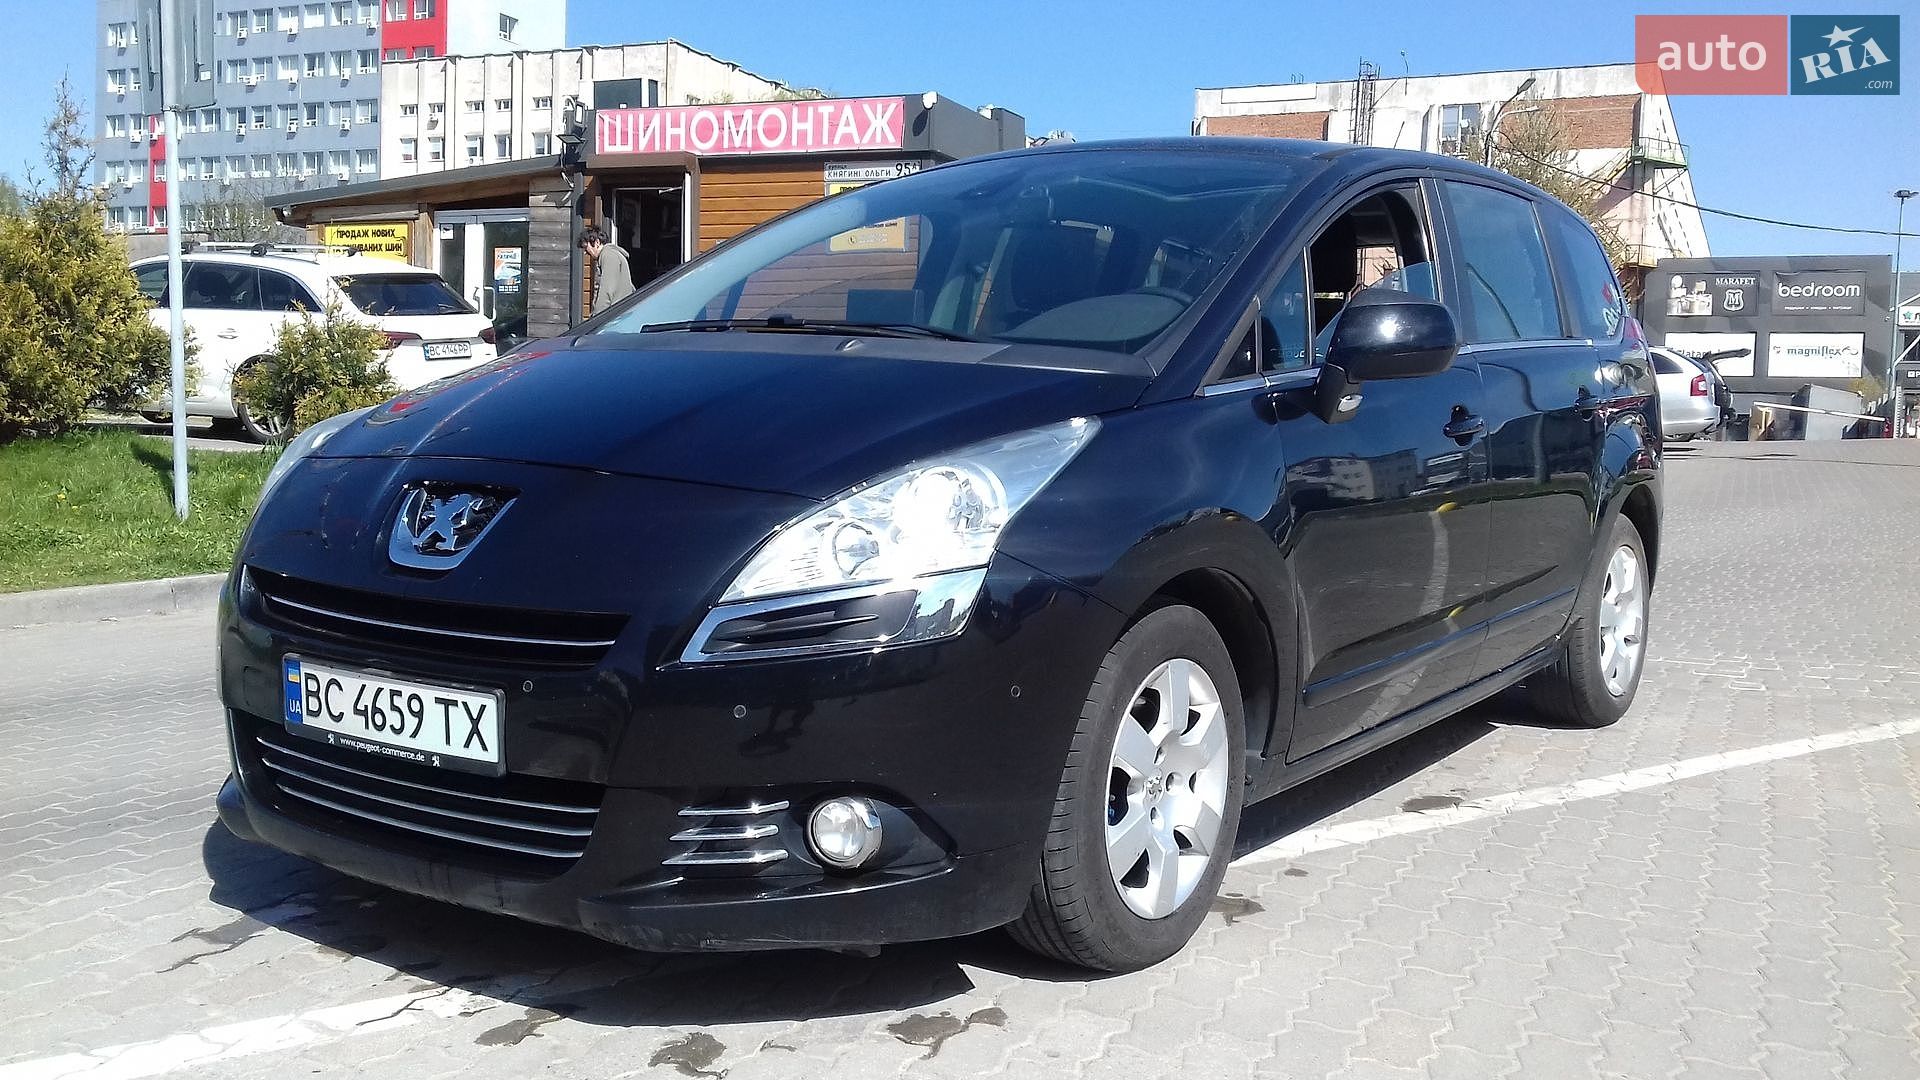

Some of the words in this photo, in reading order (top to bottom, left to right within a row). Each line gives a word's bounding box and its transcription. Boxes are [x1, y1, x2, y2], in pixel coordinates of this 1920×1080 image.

[603, 103, 896, 152] ШИНОМОНТАЖ
[827, 170, 861, 178] КНЯГИНІ
[865, 169, 891, 177] ОЛЬГИ
[336, 228, 370, 240] ПРОДАЖ
[371, 229, 396, 238] НОВИХ
[385, 243, 402, 252] ШИН
[1715, 277, 1756, 286] MARAFET
[1778, 282, 1860, 297] bedroom
[430, 346, 441, 356] BC
[458, 343, 468, 353] PP
[1787, 346, 1842, 357] magniflex
[289, 699, 302, 714] UA
[304, 673, 345, 723] BC
[352, 683, 424, 739] 4659
[434, 697, 489, 752] TX
[340, 737, 425, 761] www.peugeot-commerce.de
